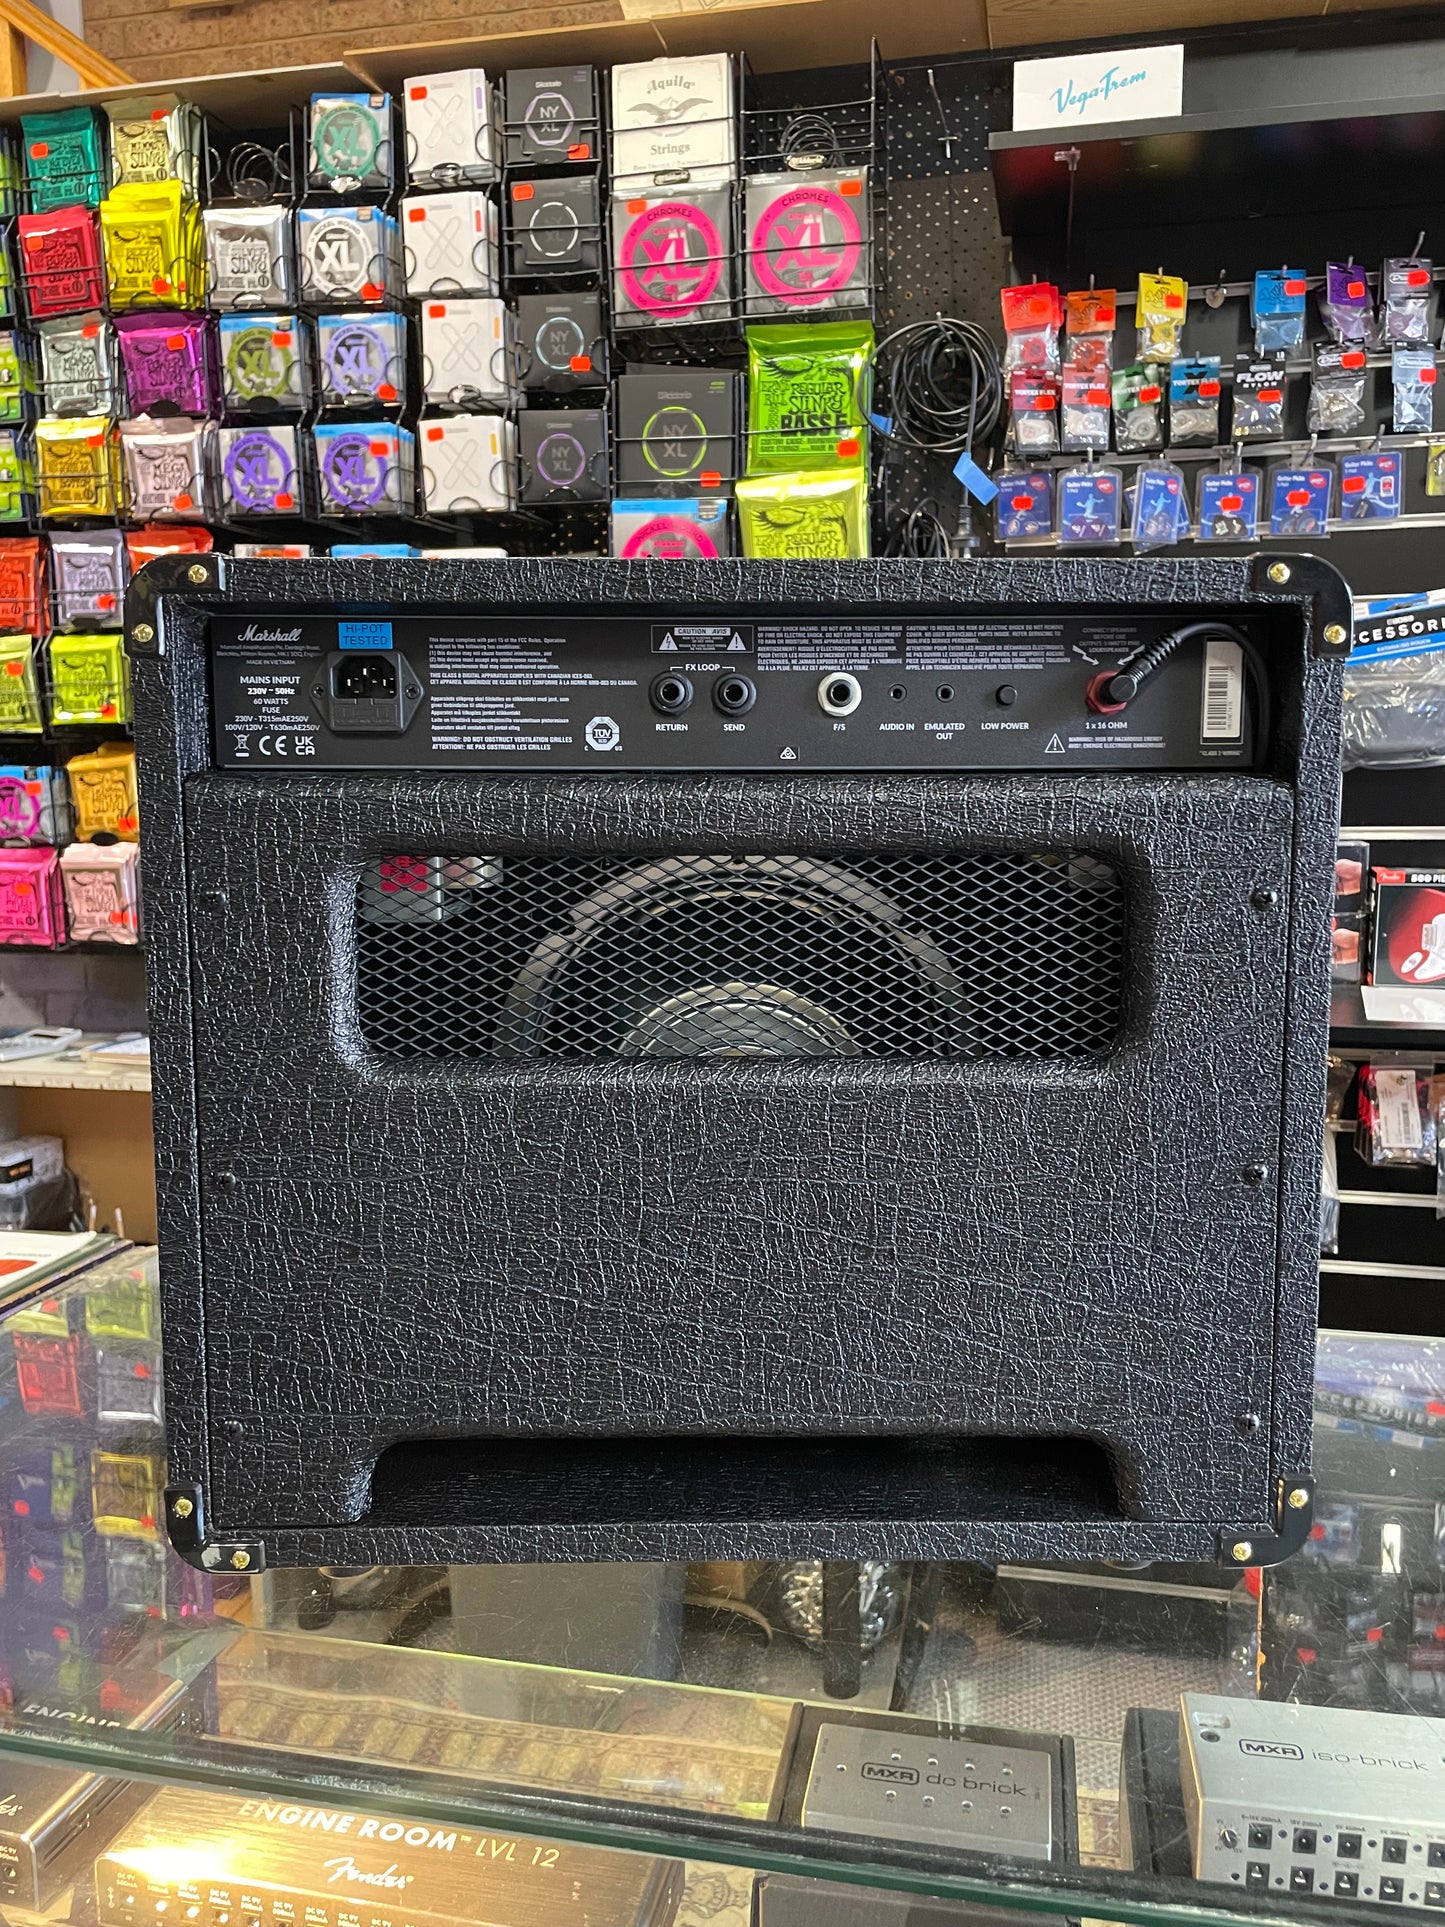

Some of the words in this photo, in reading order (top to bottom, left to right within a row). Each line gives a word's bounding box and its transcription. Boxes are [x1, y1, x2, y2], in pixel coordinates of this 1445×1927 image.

[540, 106, 560, 118] NY
[330, 125, 367, 158] XL
[650, 143, 691, 156] Strings
[781, 190, 830, 207] CHROMES
[646, 206, 693, 223] CHROMES
[774, 223, 840, 271] XL
[318, 240, 361, 273] XL
[640, 238, 704, 285] XL
[550, 331, 570, 344] NY
[551, 343, 571, 356] XL
[240, 350, 280, 380] XL
[337, 346, 378, 375] XL
[1236, 371, 1285, 384] FLOW
[790, 382, 847, 396] REGULAR
[1243, 381, 1278, 390] NYLON
[788, 395, 845, 415] SLINKY
[781, 414, 833, 437] BASS
[550, 447, 571, 459] NY
[663, 442, 689, 458] XL
[238, 456, 280, 487] XL
[335, 456, 376, 486] XL
[552, 459, 572, 472] XL
[635, 522, 668, 543] NICKEL
[784, 531, 841, 546] REGULAR
[237, 624, 302, 642] Marshall
[345, 623, 385, 634] HI-POT
[342, 635, 388, 646] TESTED
[685, 663, 697, 671] FX
[697, 663, 721, 671] LOOP
[240, 676, 271, 685] MAINS
[271, 676, 301, 685] INPUT
[247, 687, 268, 695] 230V
[274, 687, 296, 695] 50Hz
[235, 715, 254, 723] 230V
[258, 715, 309, 723] T315mAE250V
[224, 724, 264, 732] 100V/120V
[269, 724, 321, 732] T630mAE250V
[655, 723, 689, 731] RETURN
[723, 723, 746, 732] SEND
[833, 723, 846, 731] F/S
[879, 723, 905, 731] AUDIO
[904, 723, 916, 731] IN
[924, 723, 966, 731] EMULATED
[981, 722, 1000, 730] LOW
[1000, 722, 1030, 730] POWER
[1085, 722, 1091, 730] 1
[1097, 722, 1107, 730] 16
[1107, 722, 1128, 730] OHM
[294, 736, 315, 746] UK
[936, 732, 954, 740] OUT
[258, 735, 288, 756] CE
[295, 745, 316, 756] CA
[1245, 1743, 1298, 1757] MXR
[1312, 1750, 1430, 1772] iso-brick
[866, 1767, 915, 1783] MXR
[926, 1772, 957, 1787] dc
[963, 1777, 1027, 1797] brick
[237, 1800, 356, 1834] ENGINE
[475, 1837, 516, 1862] LVL
[530, 1846, 561, 1868] 12
[117, 1872, 127, 1881] DC
[323, 1856, 408, 1889] Fender
[209, 1889, 219, 1898] DC
[305, 1907, 315, 1915] DC
